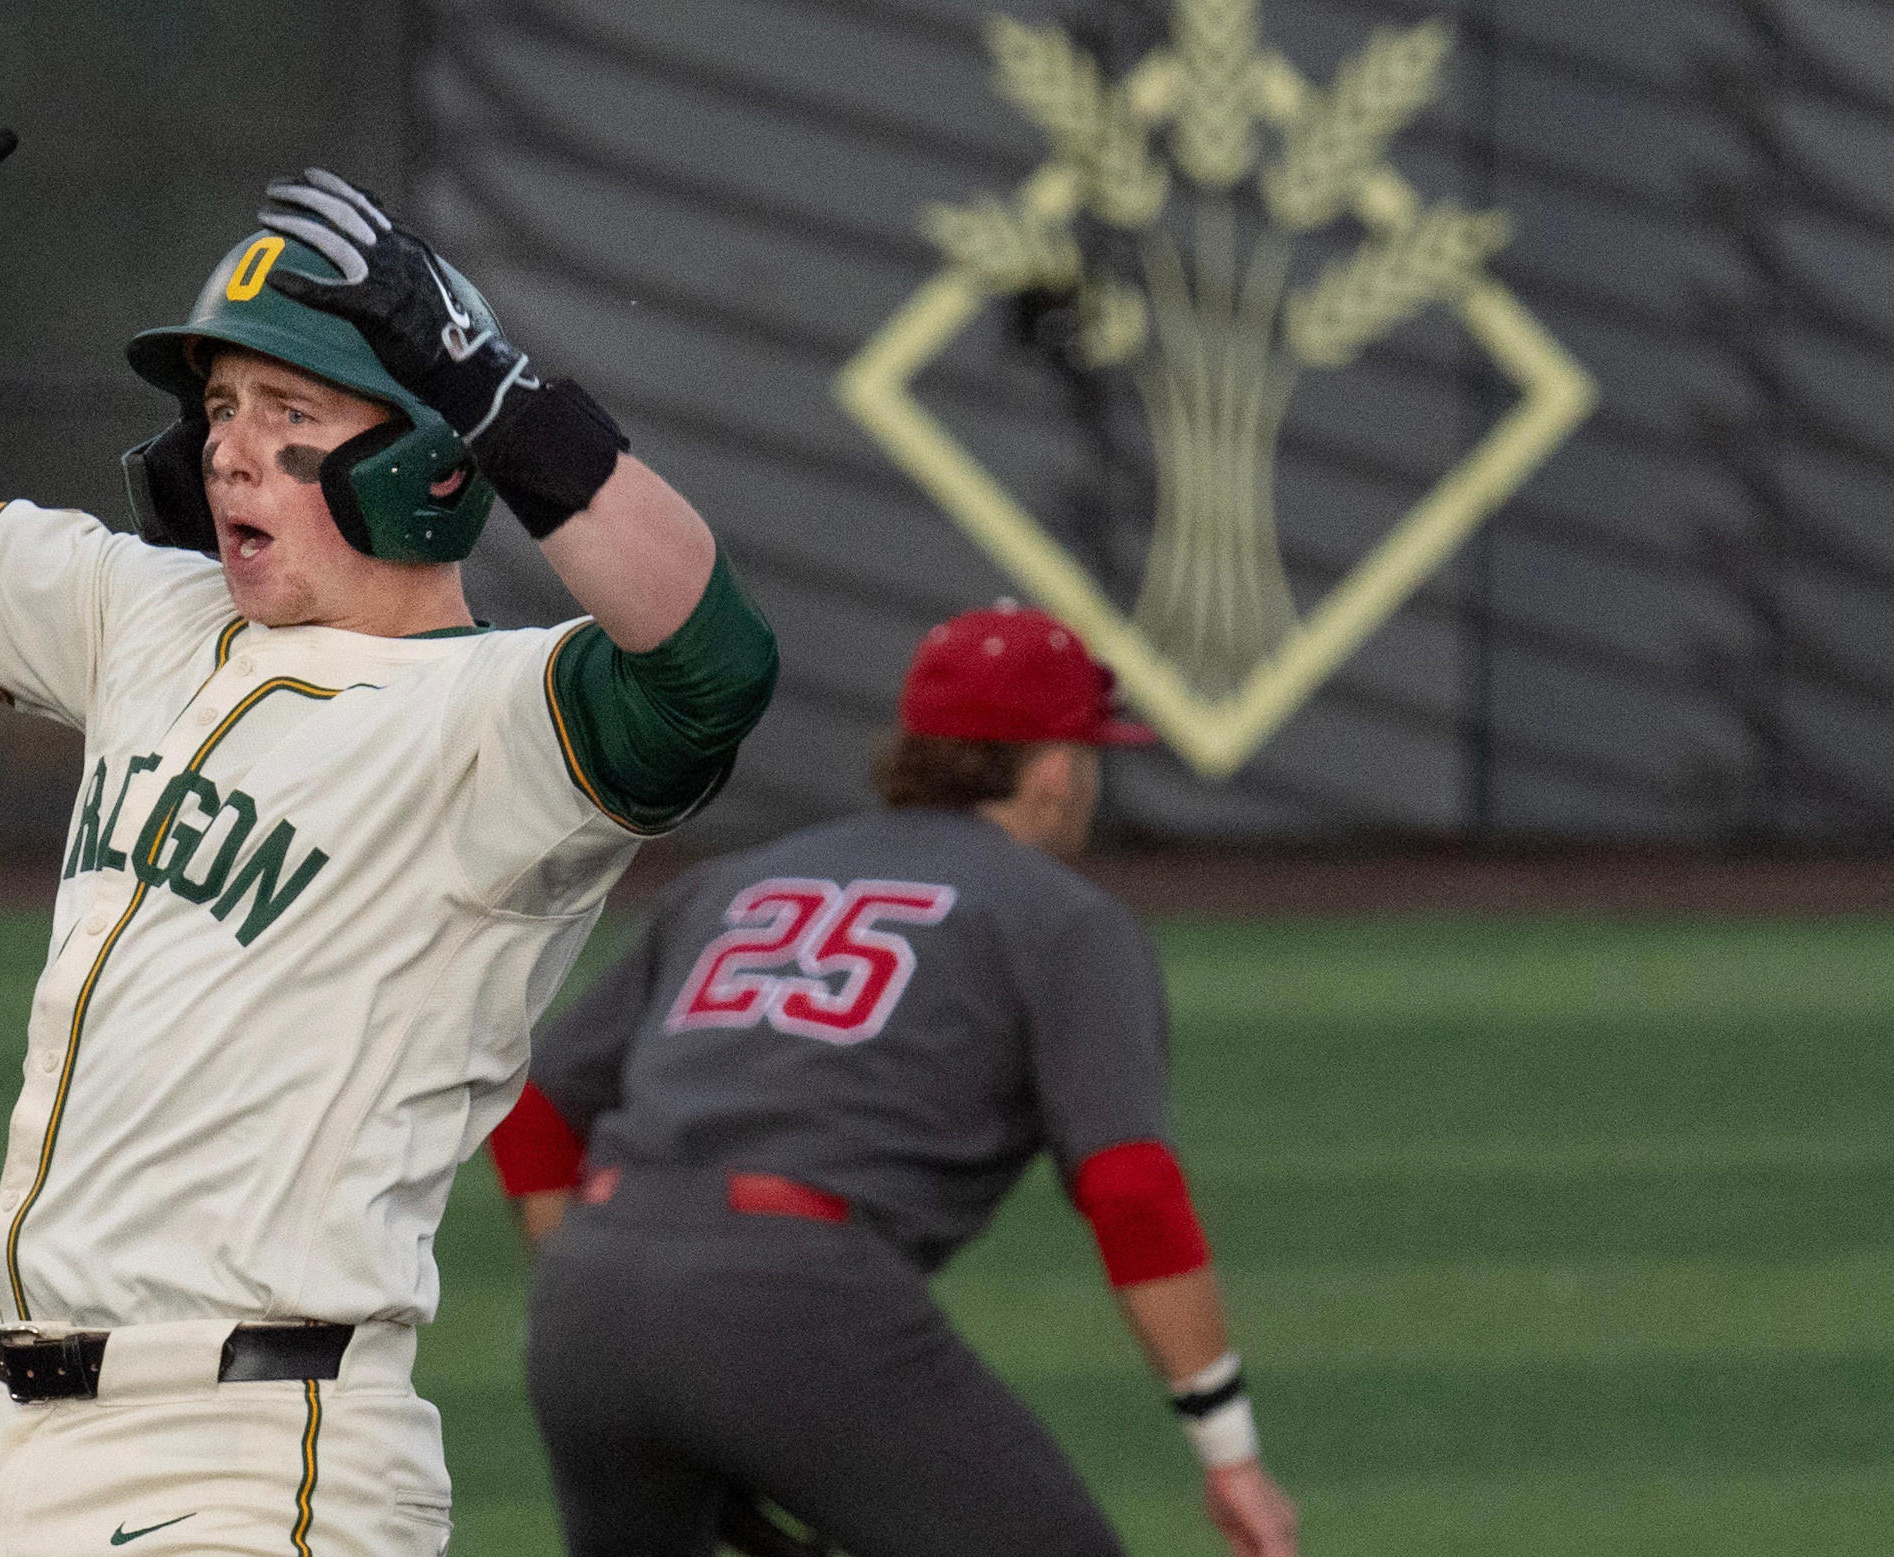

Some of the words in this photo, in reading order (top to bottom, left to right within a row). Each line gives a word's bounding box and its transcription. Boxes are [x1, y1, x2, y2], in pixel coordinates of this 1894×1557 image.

[227, 236, 286, 302] O
[63, 752, 331, 947] REGON
[664, 876, 958, 1047] 25
